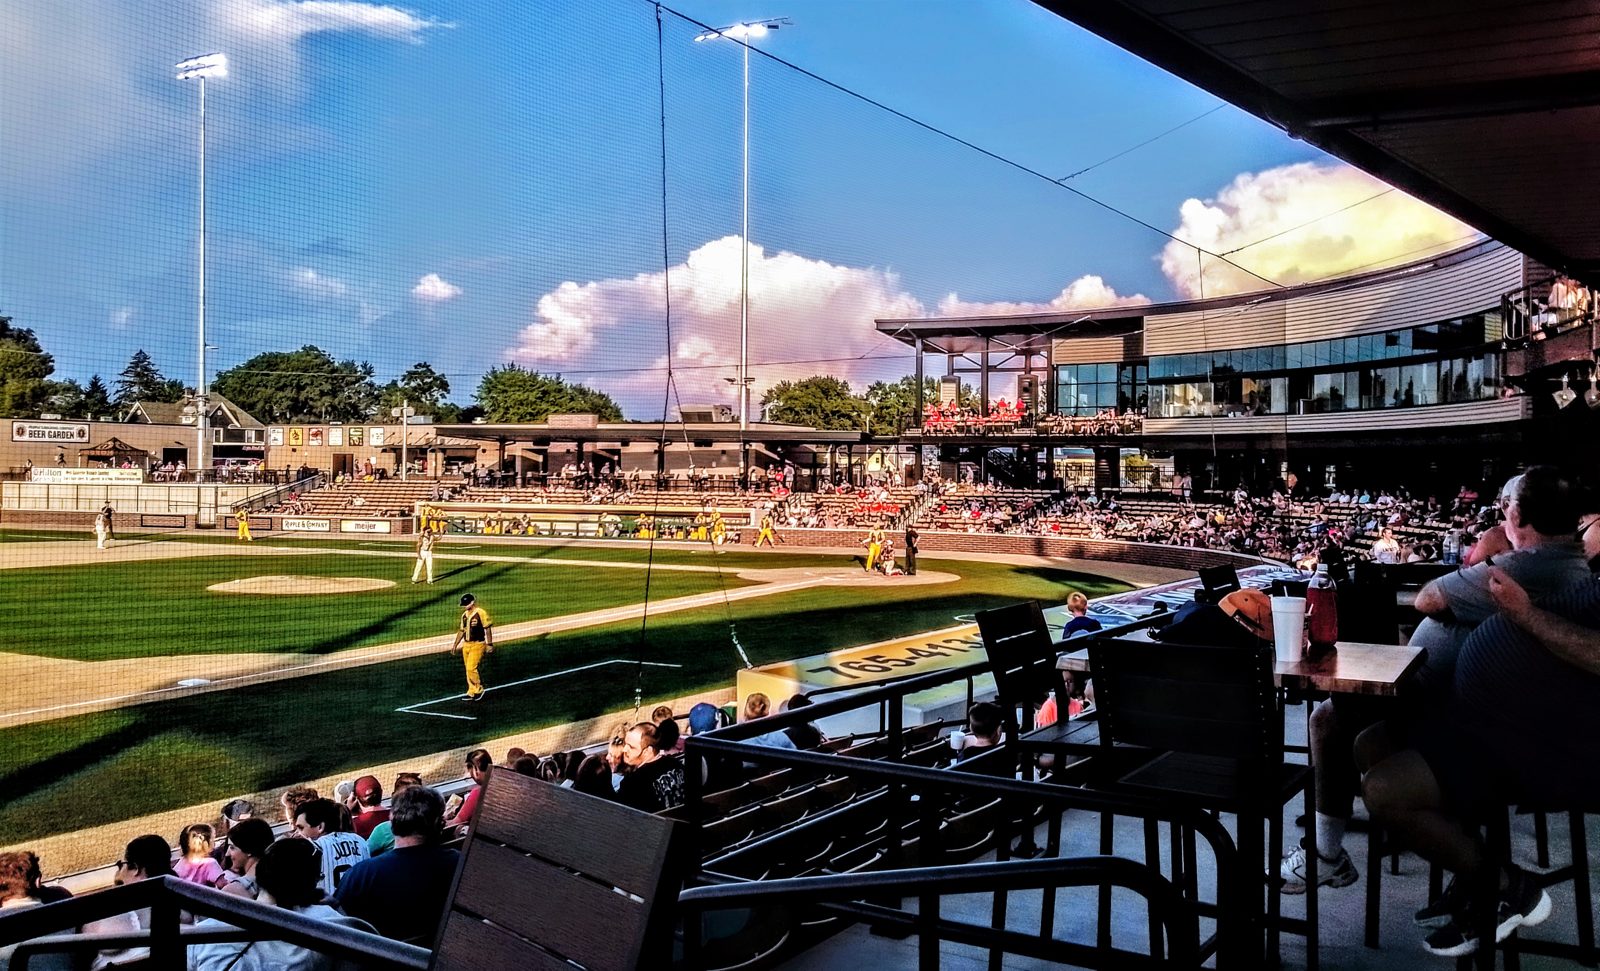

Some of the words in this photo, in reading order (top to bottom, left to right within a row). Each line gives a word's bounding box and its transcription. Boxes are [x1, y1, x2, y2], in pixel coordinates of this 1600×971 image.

[28, 430, 46, 439] BEER
[47, 430, 75, 440] GARDEN
[306, 520, 328, 530] COMPANY
[354, 522, 376, 531] meijer
[806, 633, 983, 679] 765-413
